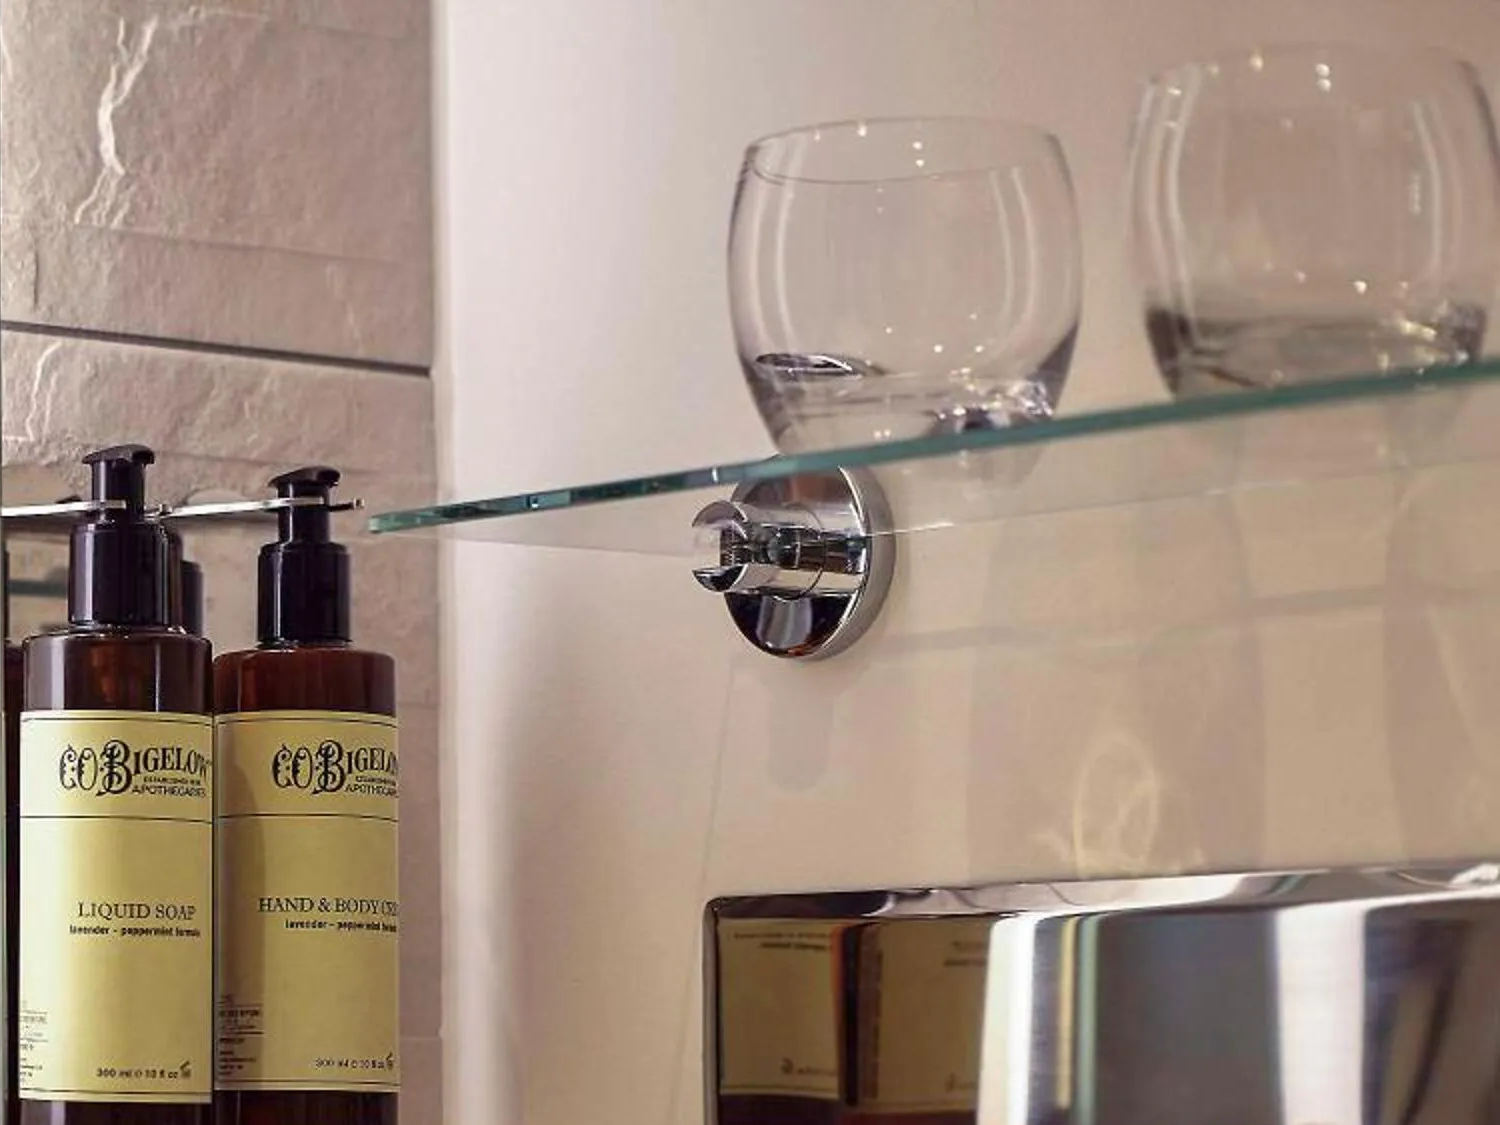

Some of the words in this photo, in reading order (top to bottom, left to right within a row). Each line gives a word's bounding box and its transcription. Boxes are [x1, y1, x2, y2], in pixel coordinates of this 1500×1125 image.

[77, 901, 151, 921] LIQUID
[155, 903, 197, 921] SOAP
[258, 896, 315, 913] HAND
[317, 897, 331, 913] &
[334, 897, 379, 914] BODY
[69, 924, 110, 936] lavender
